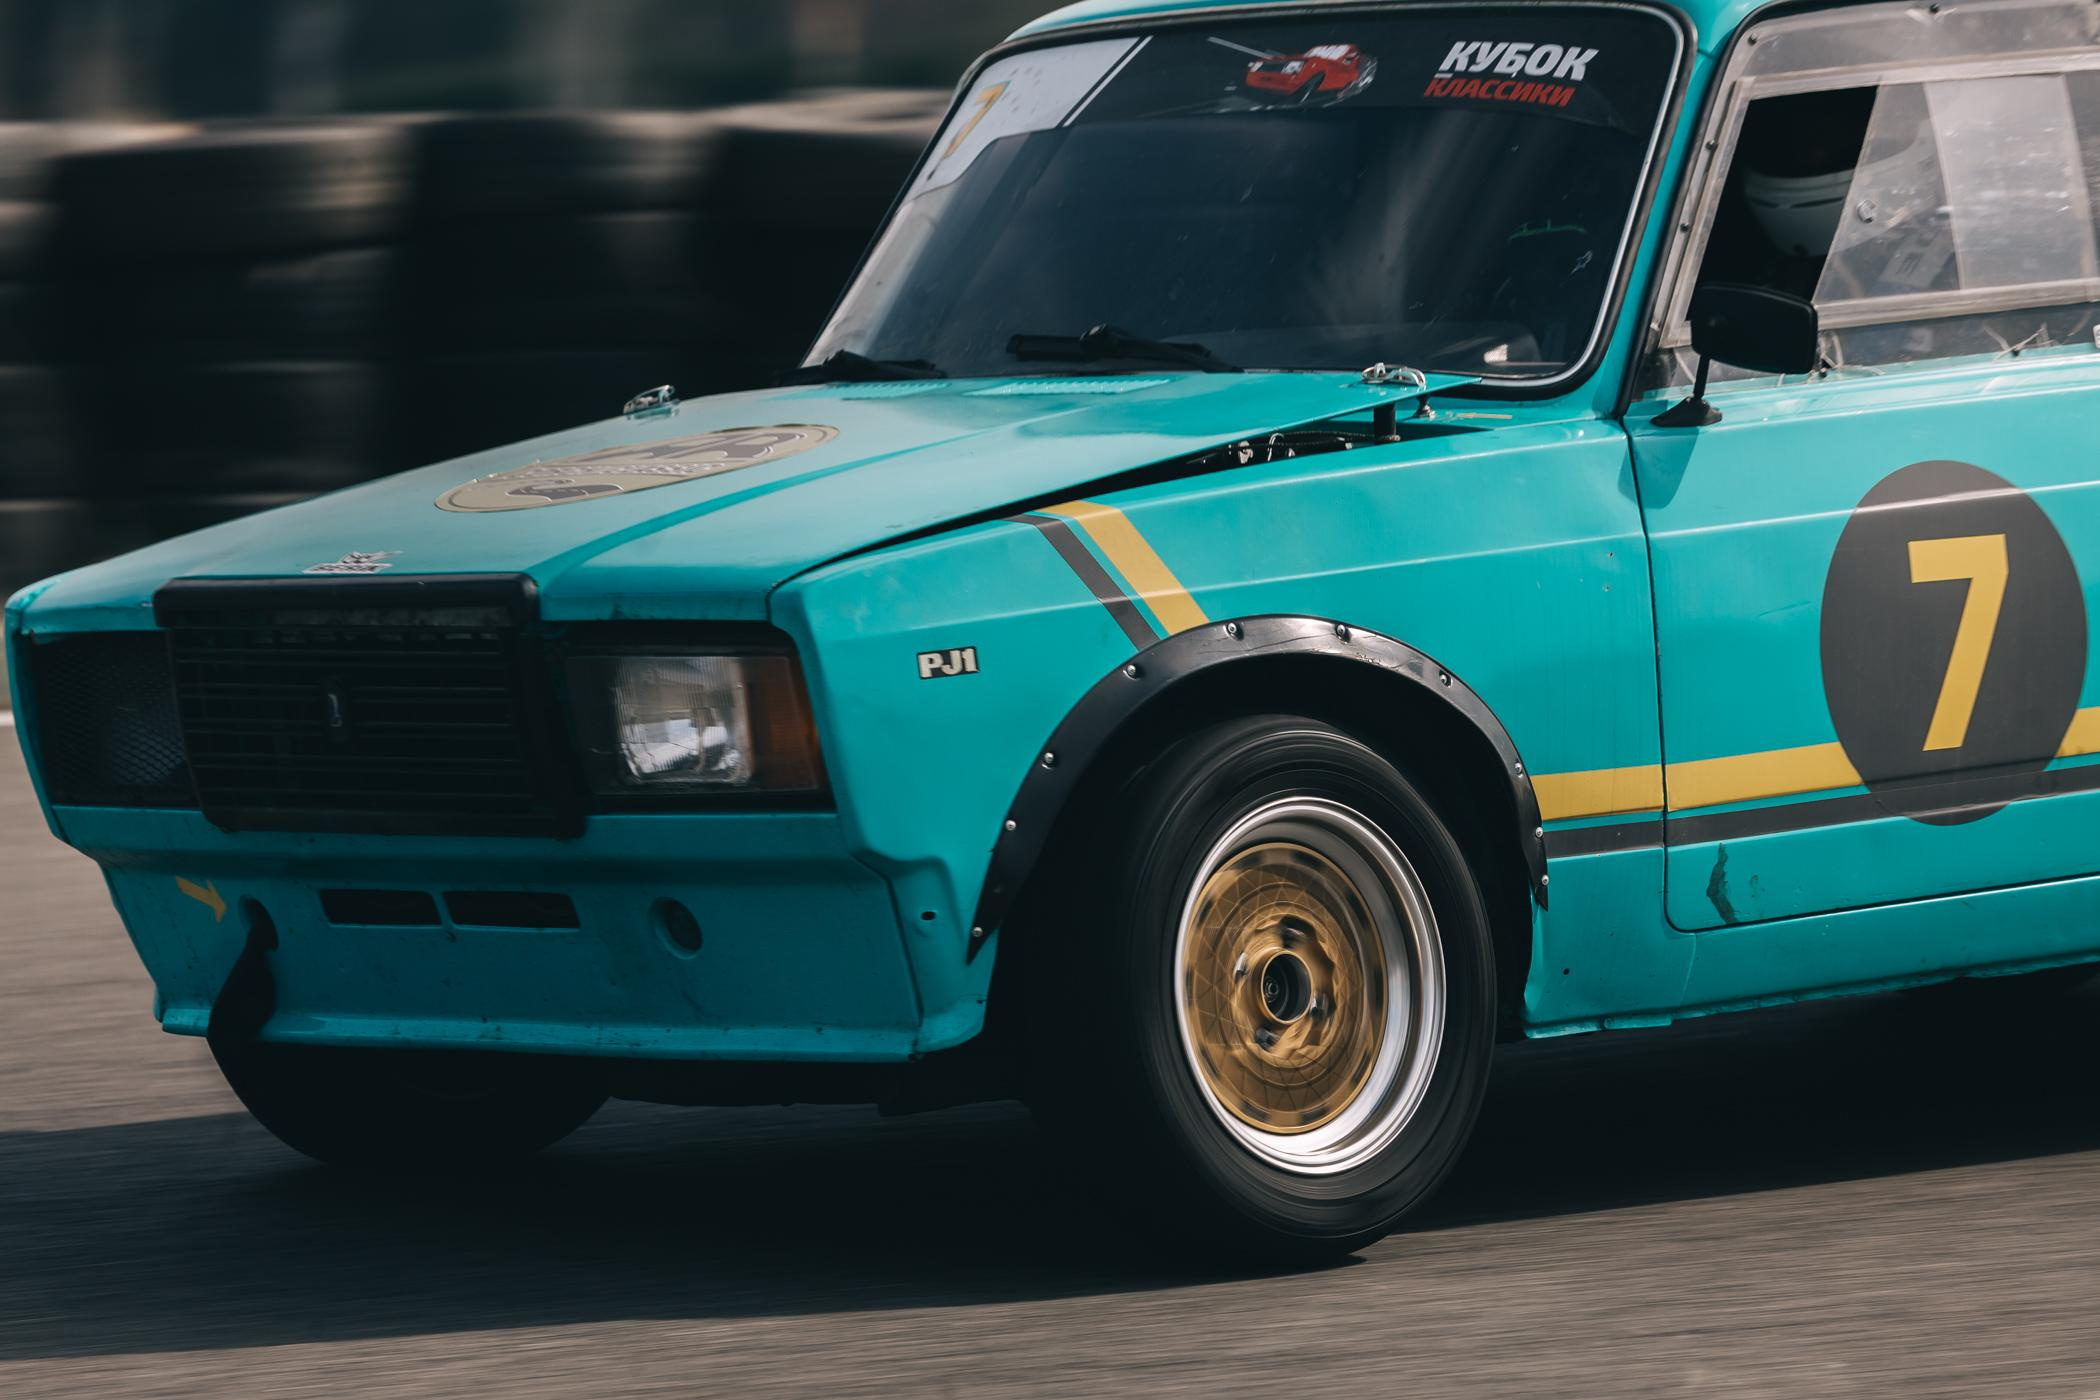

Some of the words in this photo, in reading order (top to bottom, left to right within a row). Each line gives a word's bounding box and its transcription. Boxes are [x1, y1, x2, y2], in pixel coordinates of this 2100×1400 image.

[1438, 41, 1599, 81] КУБОК
[1424, 78, 1576, 107] КЛАССИКИ
[1908, 533, 2009, 751] 7
[917, 648, 979, 677] PJ1
